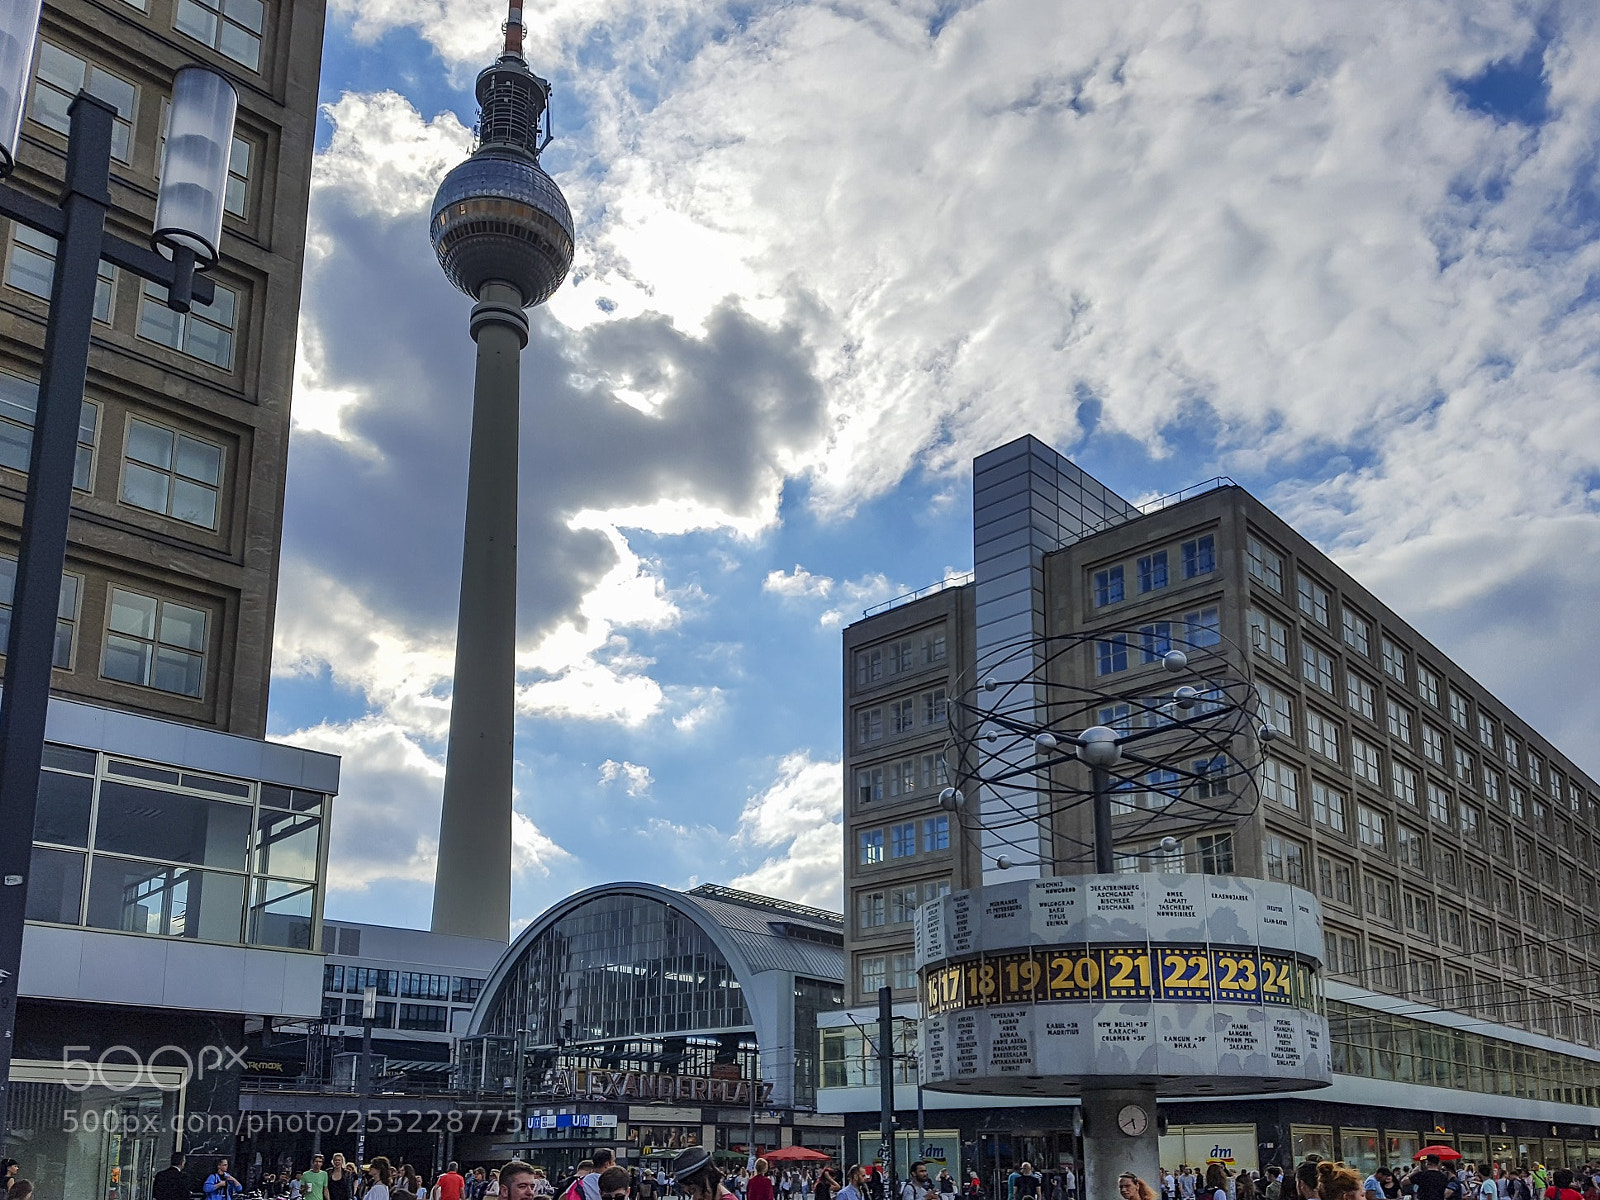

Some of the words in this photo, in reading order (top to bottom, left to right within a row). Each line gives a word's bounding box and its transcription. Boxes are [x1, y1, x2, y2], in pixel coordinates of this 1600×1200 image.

[941, 970, 960, 1002] 17
[968, 965, 996, 997] 18
[1006, 961, 1041, 992] 19
[1051, 957, 1099, 989] 20
[1109, 956, 1150, 987] 21
[1164, 956, 1210, 988] 22
[1219, 958, 1257, 990] 23
[1262, 962, 1291, 995] 24
[928, 978, 937, 1008] 16
[553, 1071, 774, 1103] ALEXANDERPLATZ
[572, 1115, 579, 1126] U
[926, 1144, 943, 1157] dm
[1210, 1145, 1231, 1157] dm
